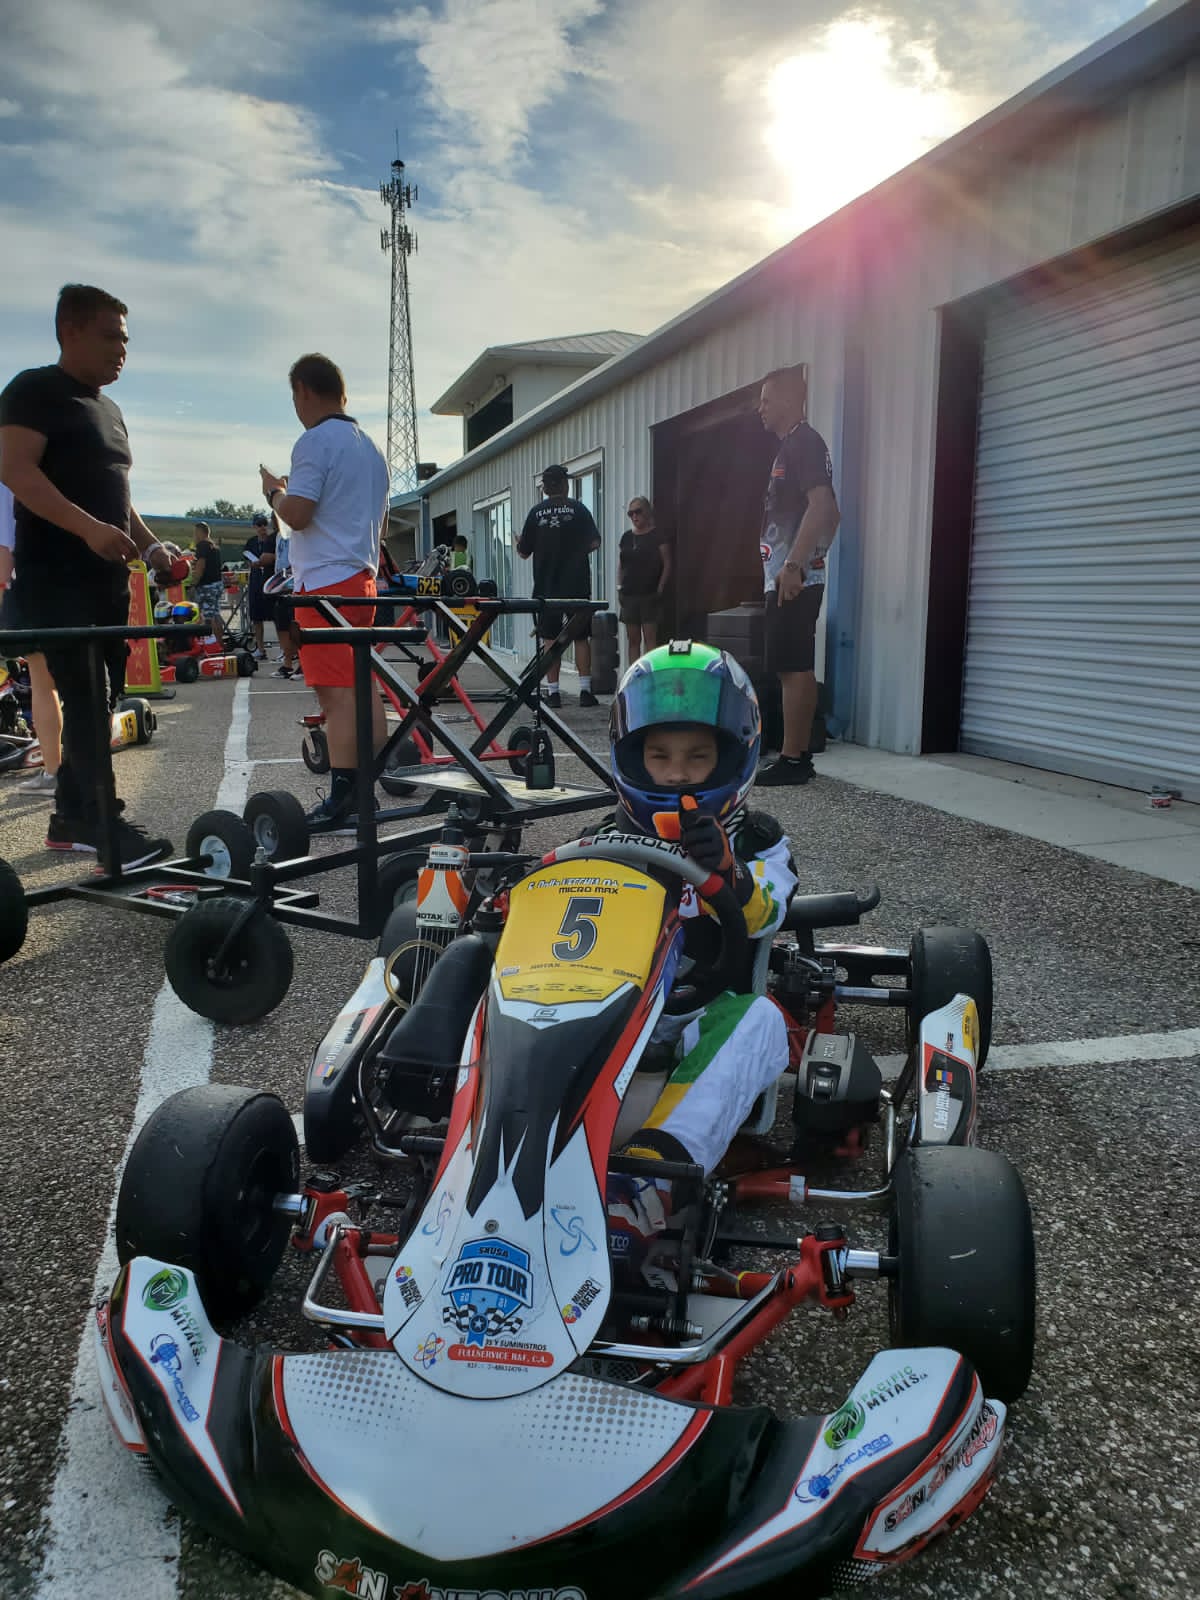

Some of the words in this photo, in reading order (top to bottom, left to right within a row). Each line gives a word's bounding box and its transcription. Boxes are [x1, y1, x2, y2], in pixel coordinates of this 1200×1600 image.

[536, 507, 551, 519] TEAM
[417, 577, 440, 595] 625
[592, 834, 690, 859] PAROLIN
[558, 886, 592, 894] MICRO
[595, 887, 619, 895] MAX
[552, 896, 604, 962] 5
[450, 1261, 483, 1288] PRO
[487, 1262, 529, 1299] TOUR
[579, 1287, 601, 1311] METAL
[500, 1340, 547, 1351] SUMINISTROS
[867, 1374, 920, 1411] METALS
